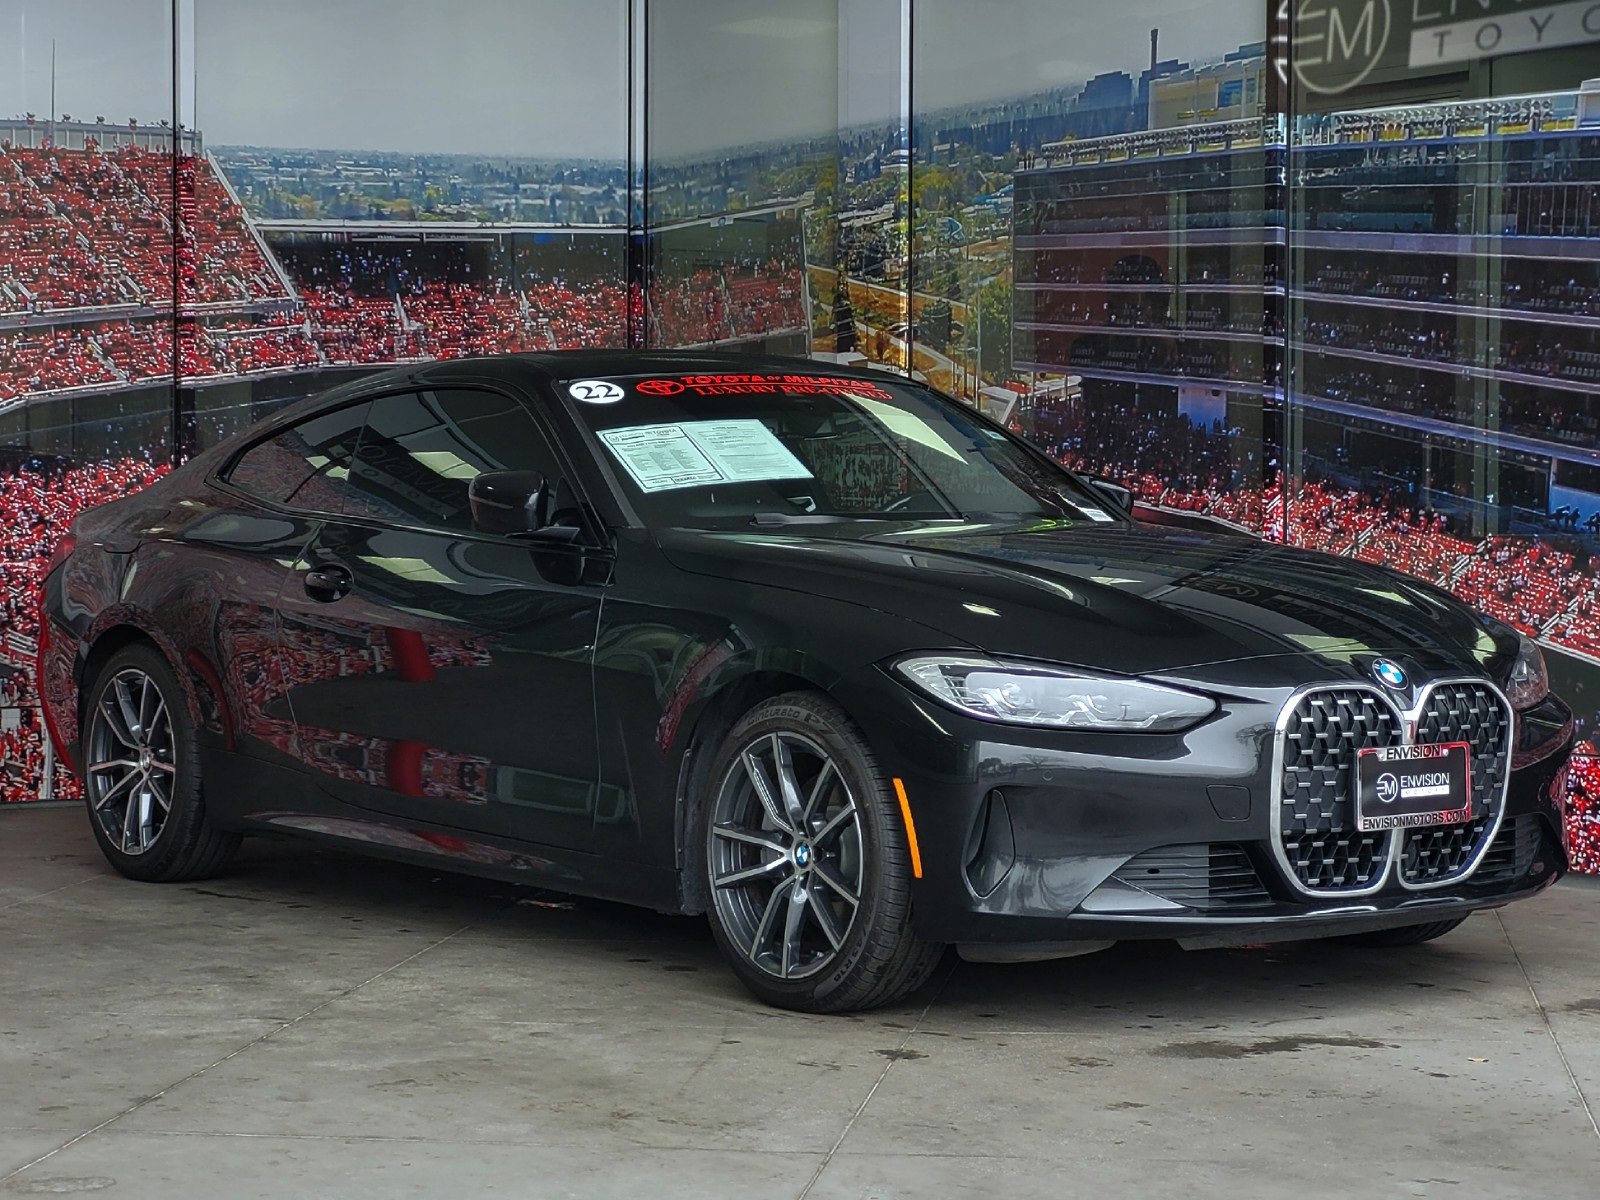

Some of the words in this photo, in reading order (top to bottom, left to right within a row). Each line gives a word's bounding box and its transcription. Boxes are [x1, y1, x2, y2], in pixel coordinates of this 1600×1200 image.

[681, 375, 766, 384] TOYOTA
[783, 375, 878, 389] MILPITAS
[575, 385, 620, 400] 22
[695, 385, 776, 396] LUXURY
[1386, 745, 1440, 760] ENVISION
[1401, 772, 1450, 788] ENVISION
[1363, 811, 1467, 830] ENVISIONMOTORS.COM
